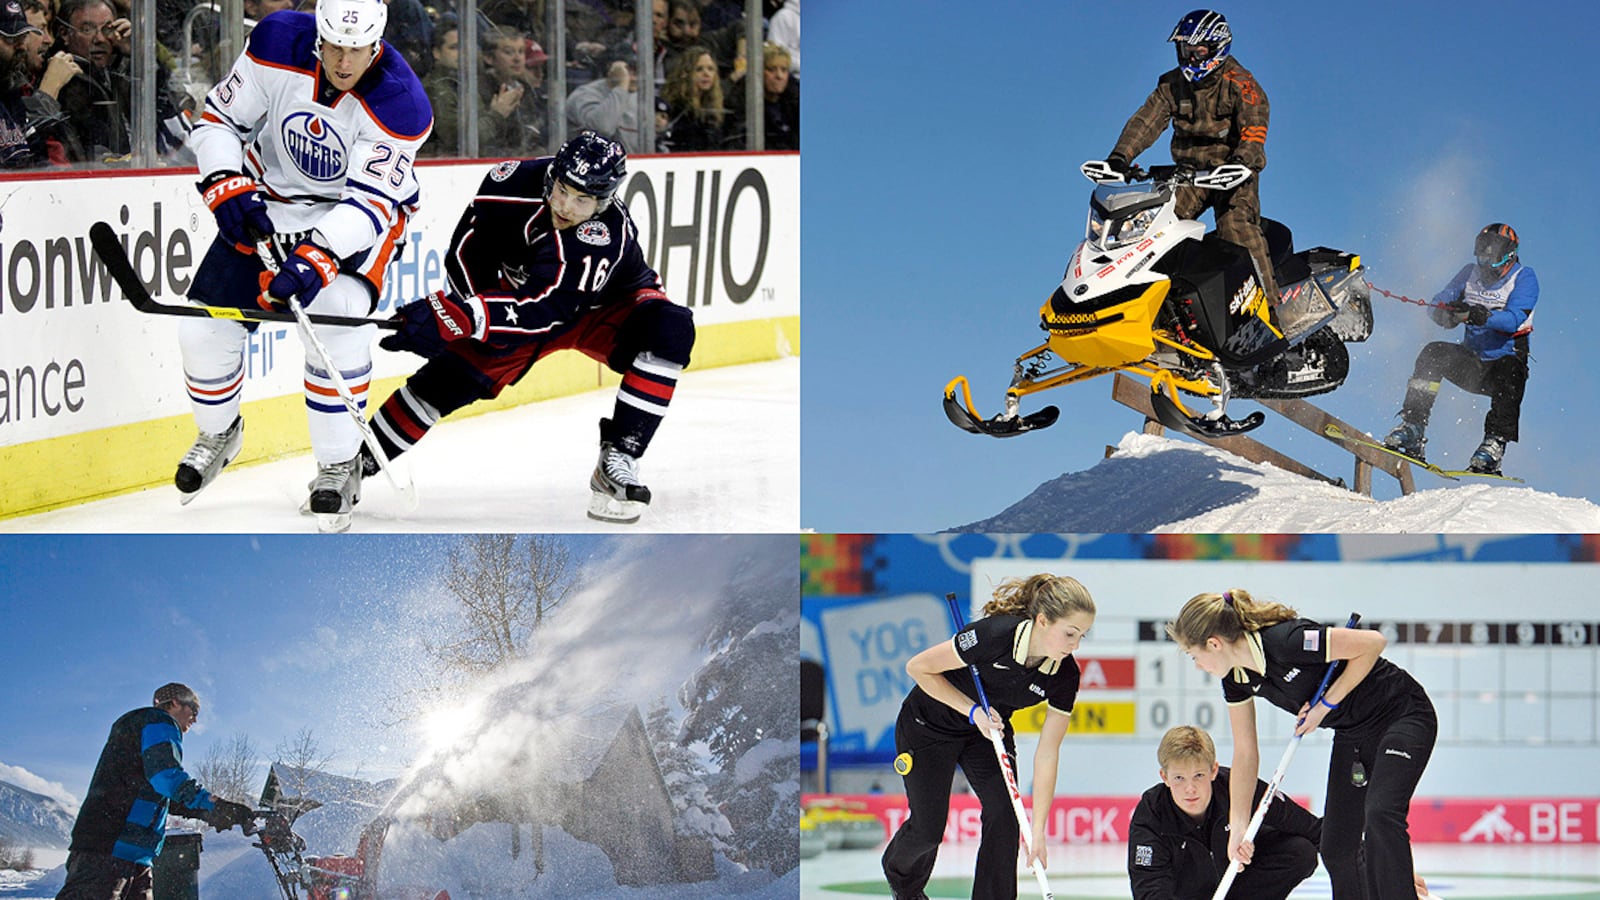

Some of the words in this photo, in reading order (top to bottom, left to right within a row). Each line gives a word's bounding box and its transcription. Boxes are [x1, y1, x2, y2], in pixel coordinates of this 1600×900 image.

[341, 11, 359, 25] 25
[287, 127, 342, 178] OILERS
[362, 141, 413, 191] 25
[574, 159, 591, 176] 16
[623, 168, 771, 307] OHIO
[577, 255, 610, 292] 16
[848, 617, 929, 665] YOG
[1556, 622, 1587, 646] 10
[1028, 682, 1046, 698] USA
[1282, 666, 1302, 683] USA
[1001, 753, 1021, 800] USA
[1529, 802, 1584, 842] BE
